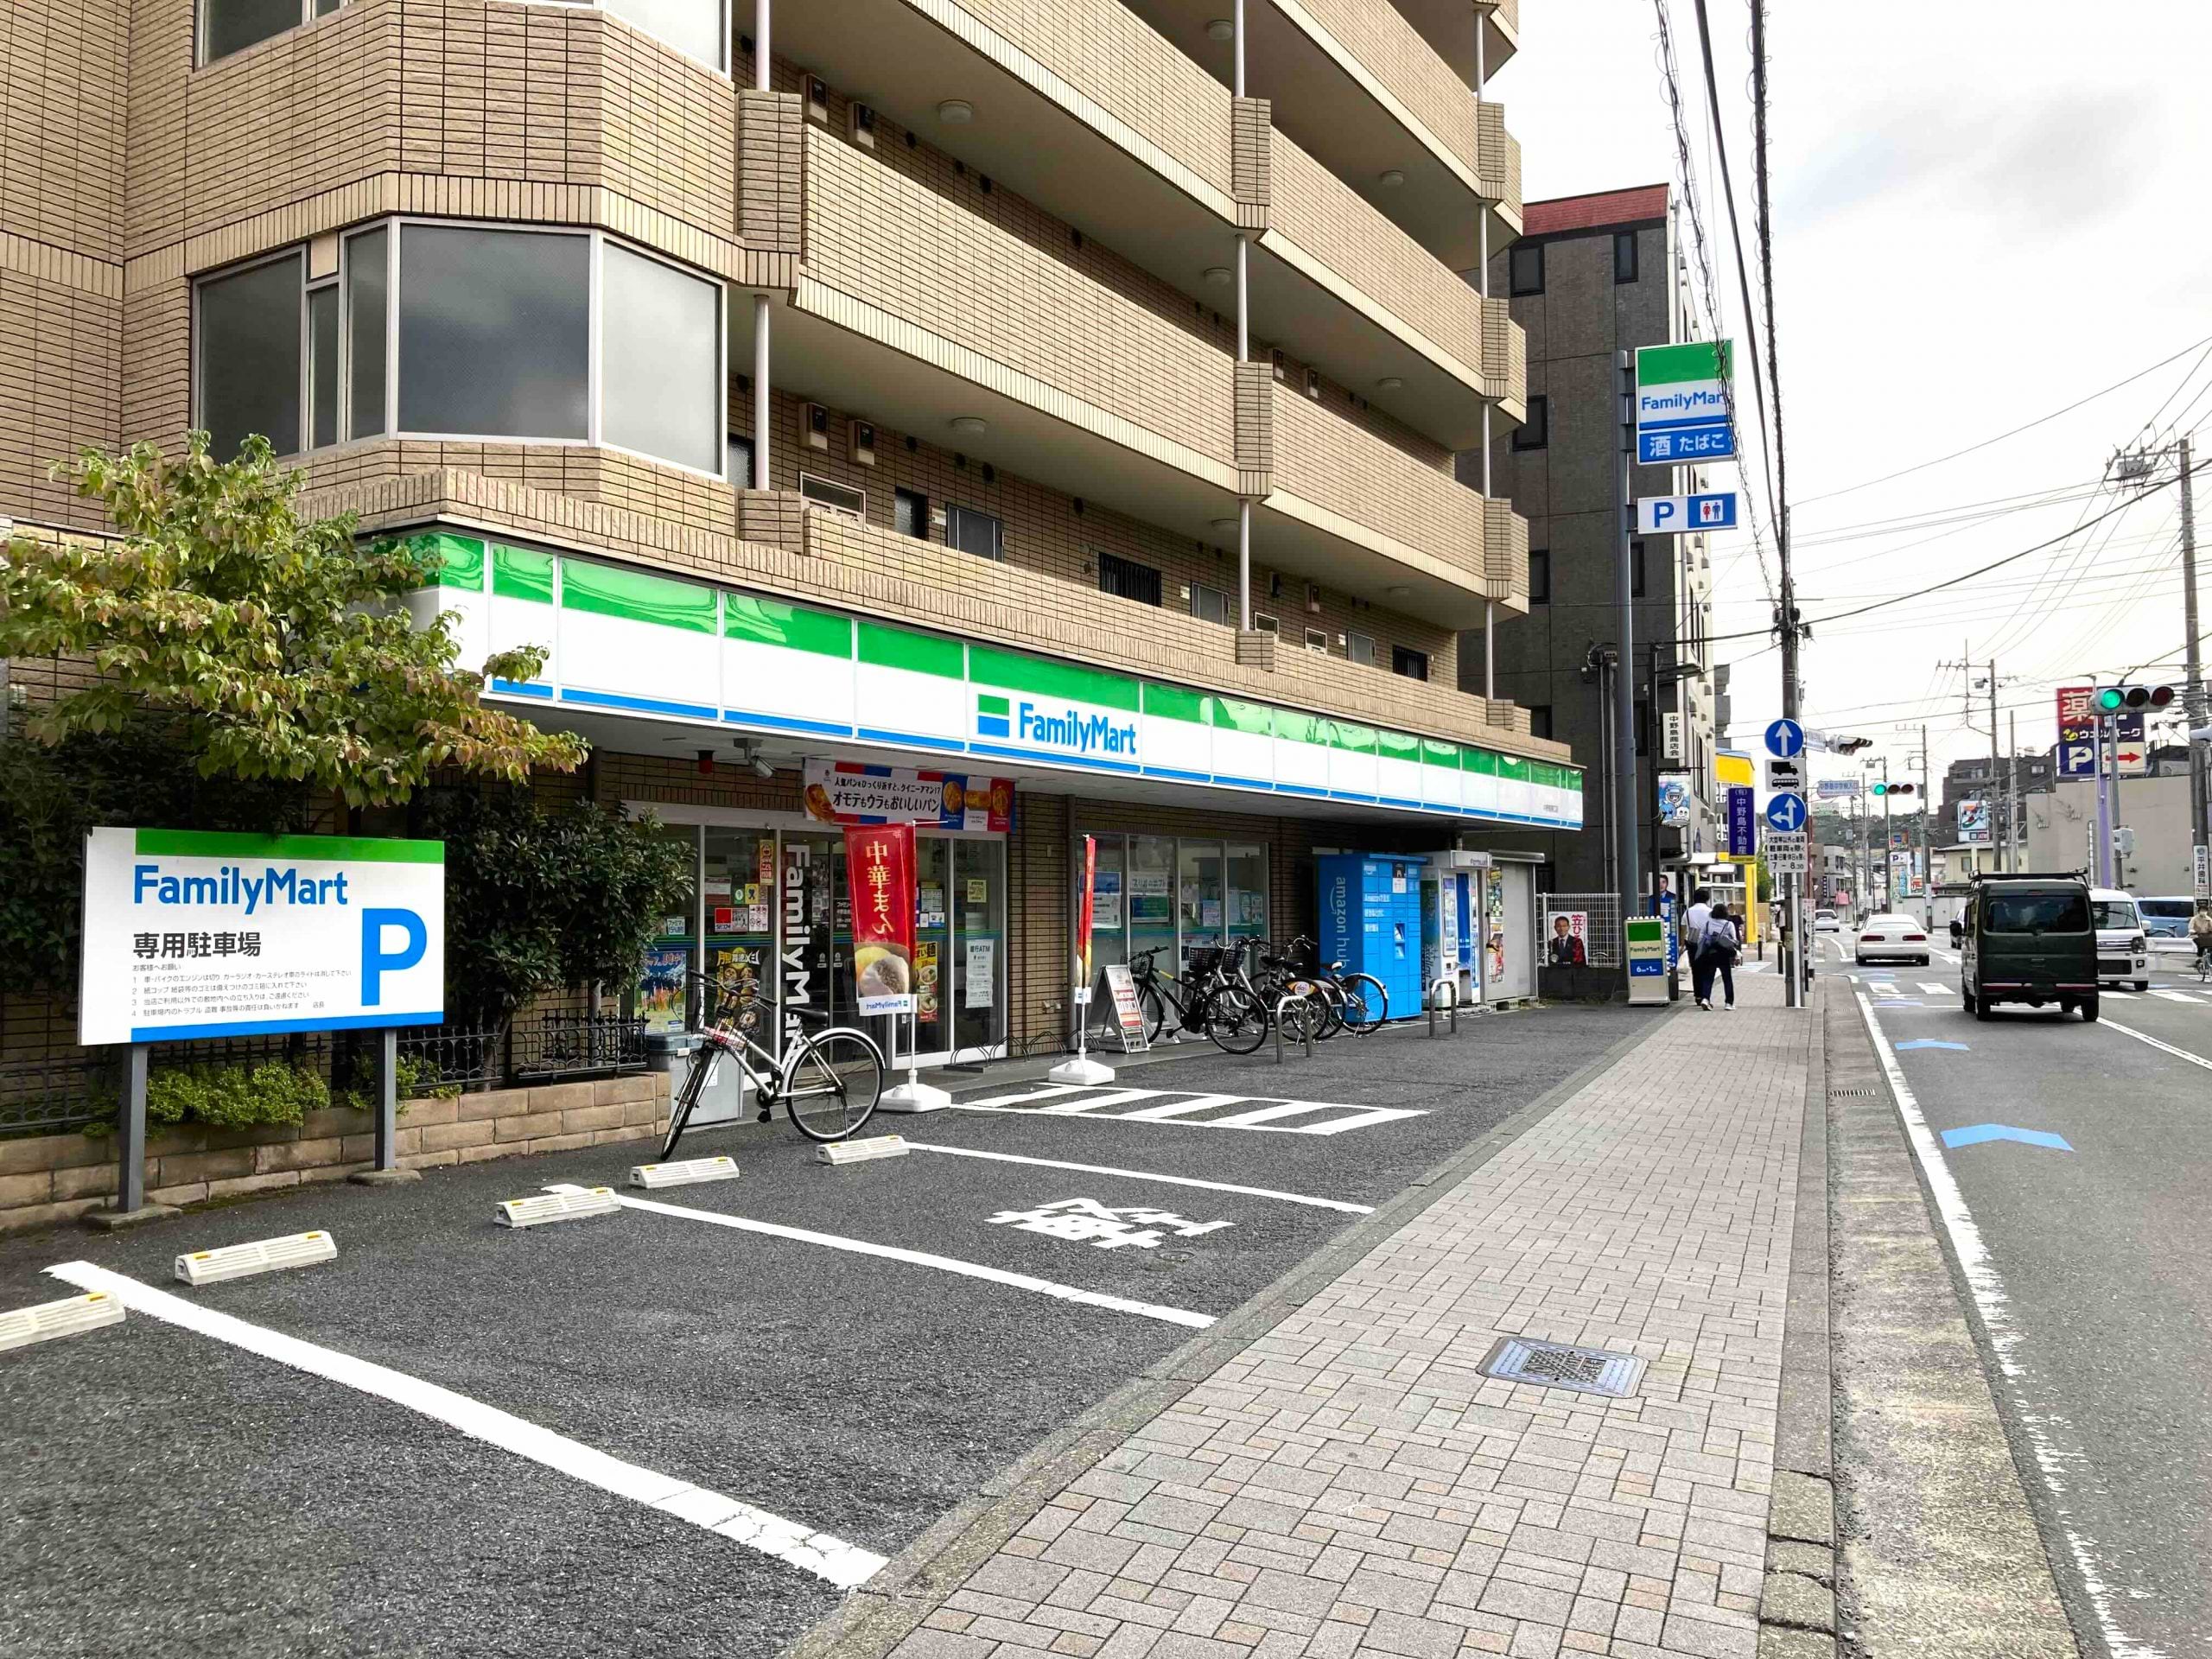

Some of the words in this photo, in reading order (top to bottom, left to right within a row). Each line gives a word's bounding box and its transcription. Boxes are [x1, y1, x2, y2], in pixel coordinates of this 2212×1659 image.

[1642, 391, 1727, 411] FamilyMar
[1649, 435, 1671, 457] 酒
[1679, 434, 1725, 453] たばこ
[1654, 502, 1675, 528] P
[2062, 691, 2094, 721] 薬
[1020, 702, 1136, 755] FamilyMart
[1669, 715, 1679, 756] 中野島商店会
[2069, 747, 2093, 772] P
[833, 791, 940, 813] オモテもウラもおいしいパン
[1736, 798, 1747, 855] 中野島不動産
[1771, 861, 1777, 870] 7
[133, 865, 347, 915] FamilyMart
[866, 841, 894, 935] 中華まん
[1336, 877, 1346, 933] amazon
[132, 931, 262, 959] 専用駐車場
[782, 844, 810, 1039] FamilyMar
[1630, 946, 1661, 955] FamilyMart
[132, 963, 181, 972] お客様へお願い
[361, 907, 428, 1007] P
